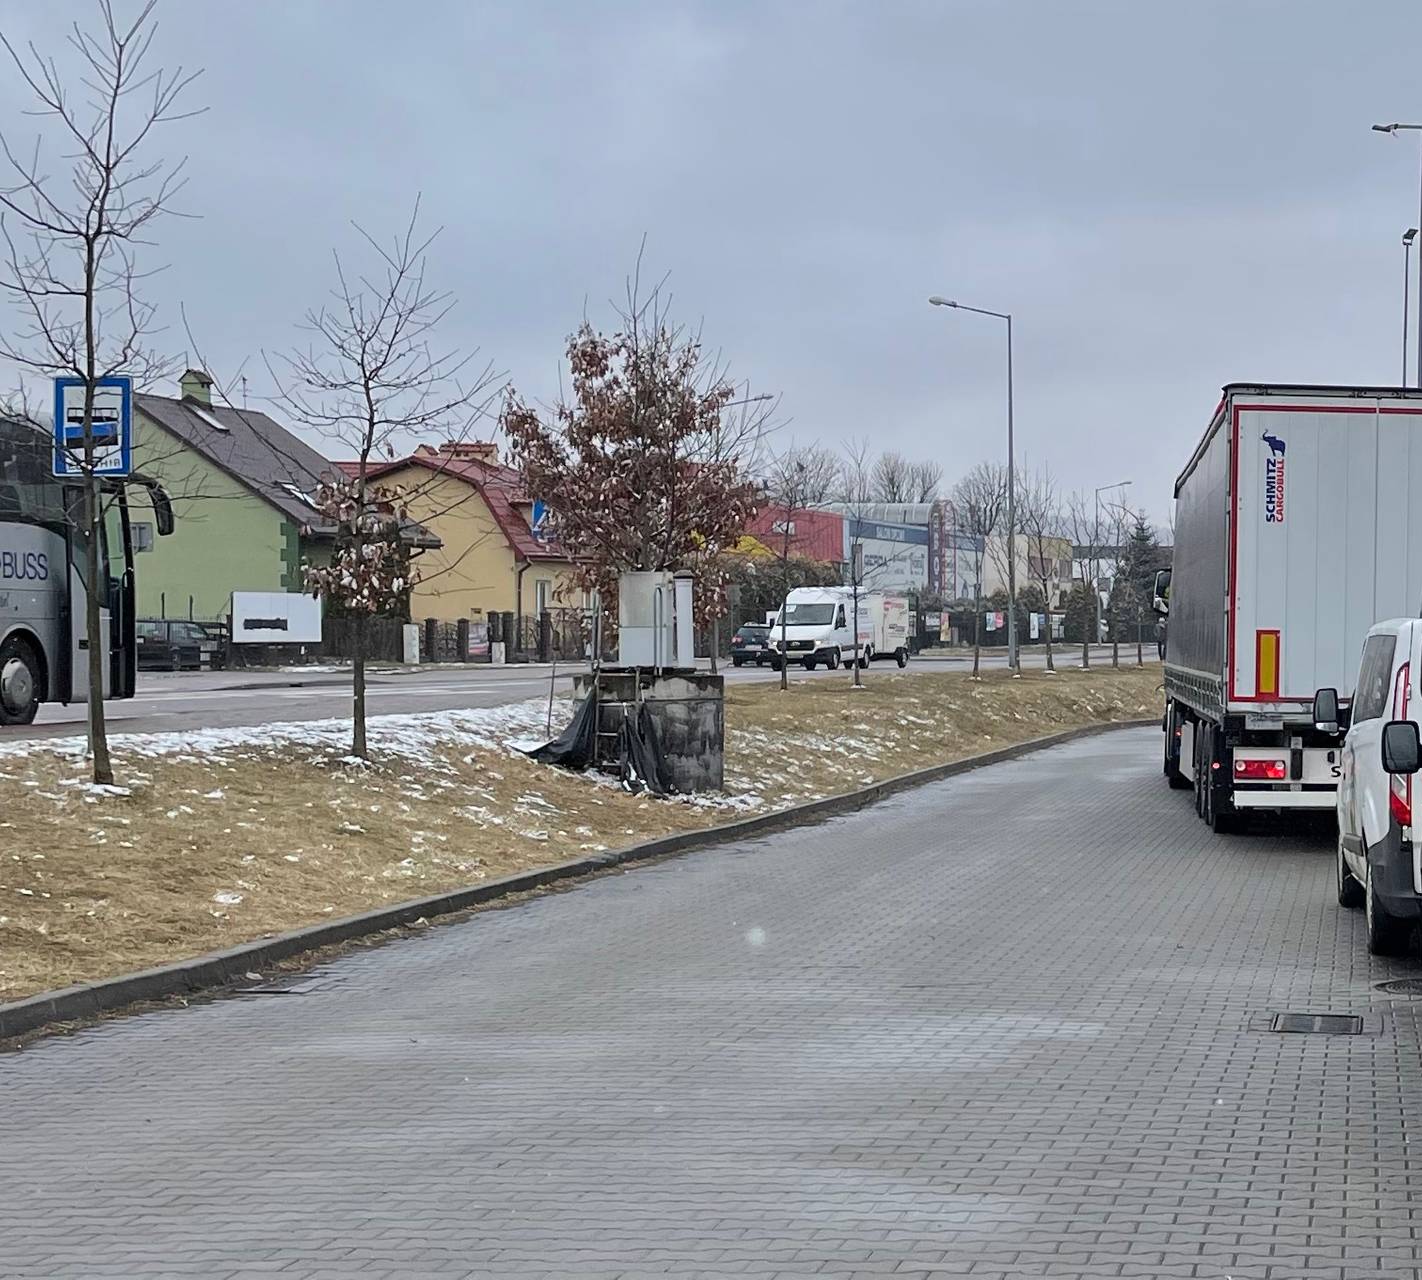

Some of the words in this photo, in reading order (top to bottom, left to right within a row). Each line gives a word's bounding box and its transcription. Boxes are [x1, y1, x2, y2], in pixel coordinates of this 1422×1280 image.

[1266, 458, 1276, 522] SCHMITZ
[1276, 458, 1284, 522] CARGOBULL
[0, 551, 49, 580] BUSS
